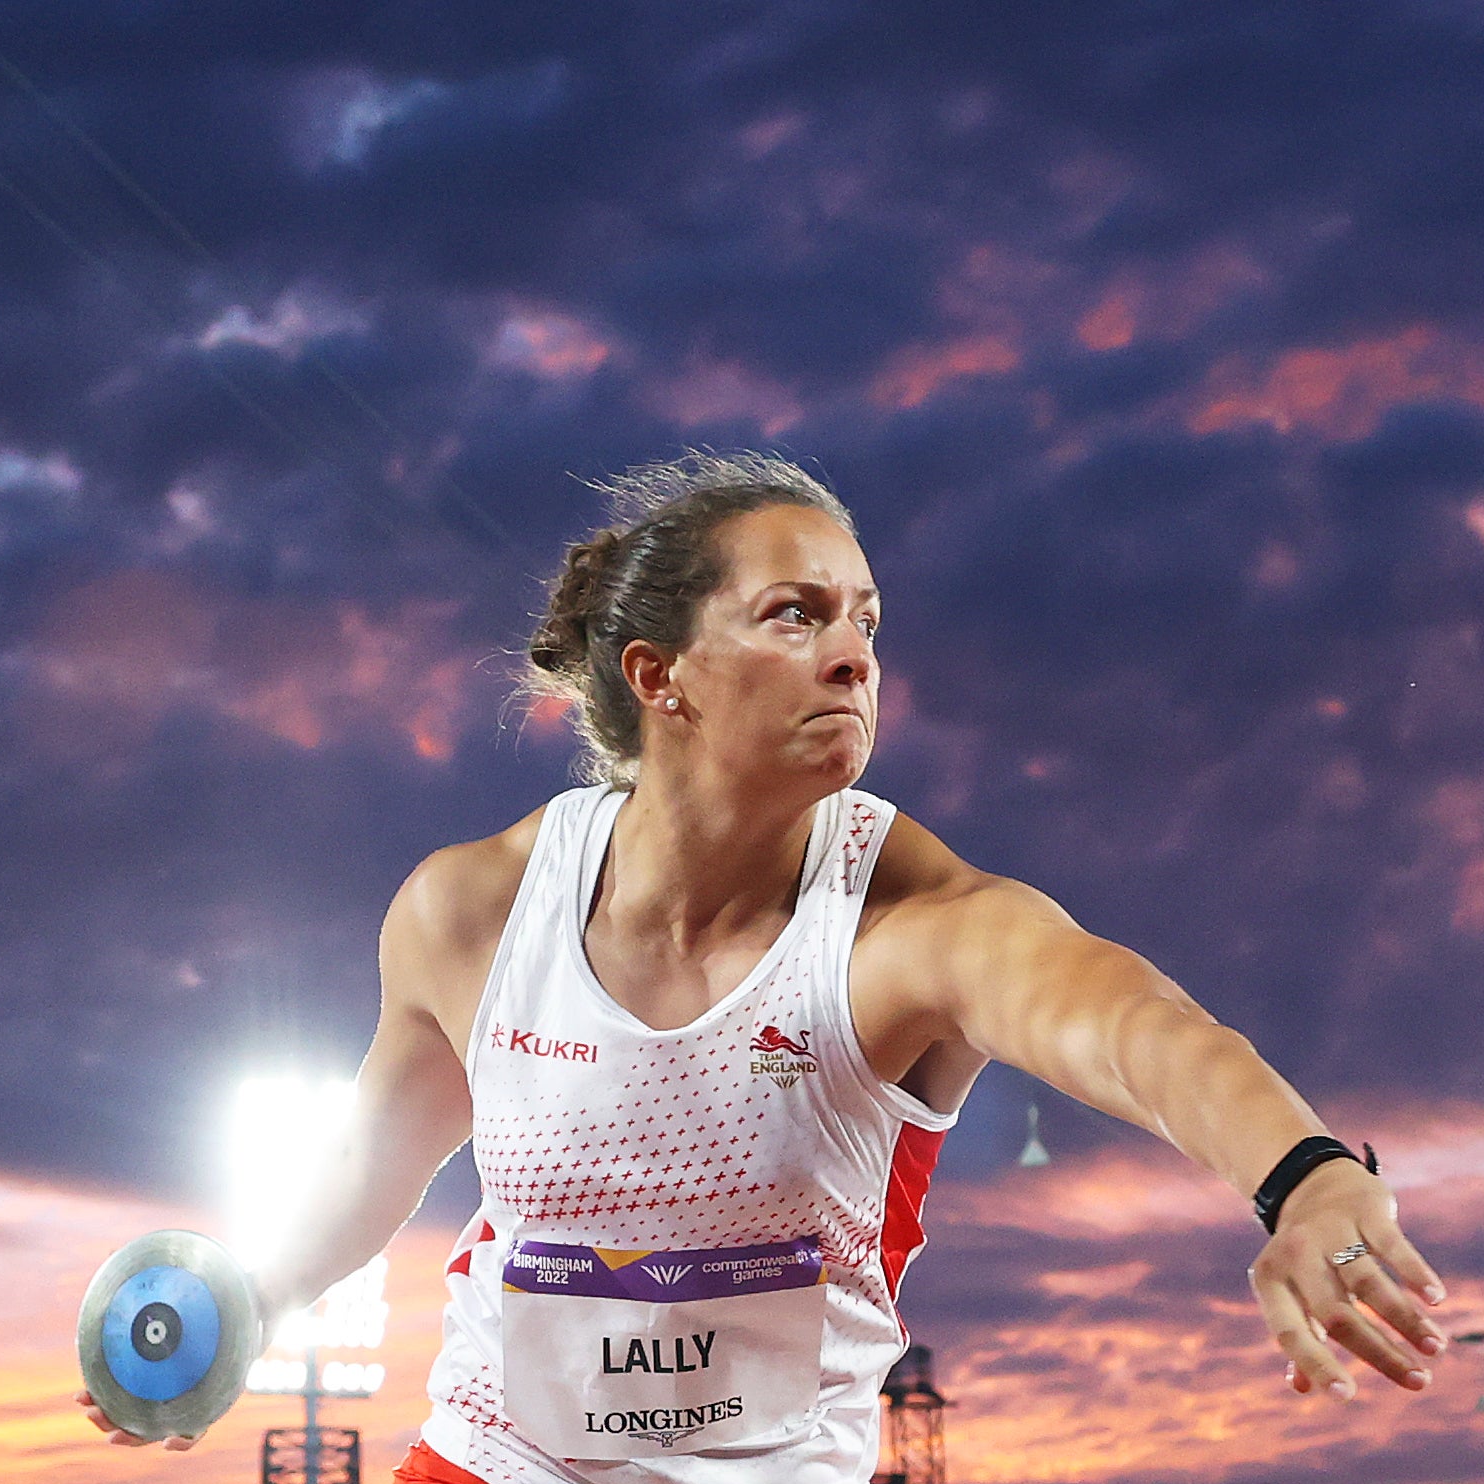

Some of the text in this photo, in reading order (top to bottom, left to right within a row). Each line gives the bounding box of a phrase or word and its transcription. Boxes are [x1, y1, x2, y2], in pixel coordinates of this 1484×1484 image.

[509, 1029, 597, 1063] KUKRI
[759, 1053, 783, 1061] TEAM
[750, 1061, 816, 1074] ENGLAND
[513, 1253, 593, 1273] BIRMINGHAM
[536, 1270, 569, 1284] 2022
[732, 1266, 783, 1284] games
[603, 1330, 716, 1374] LALLY
[585, 1396, 743, 1433] LONGINES
